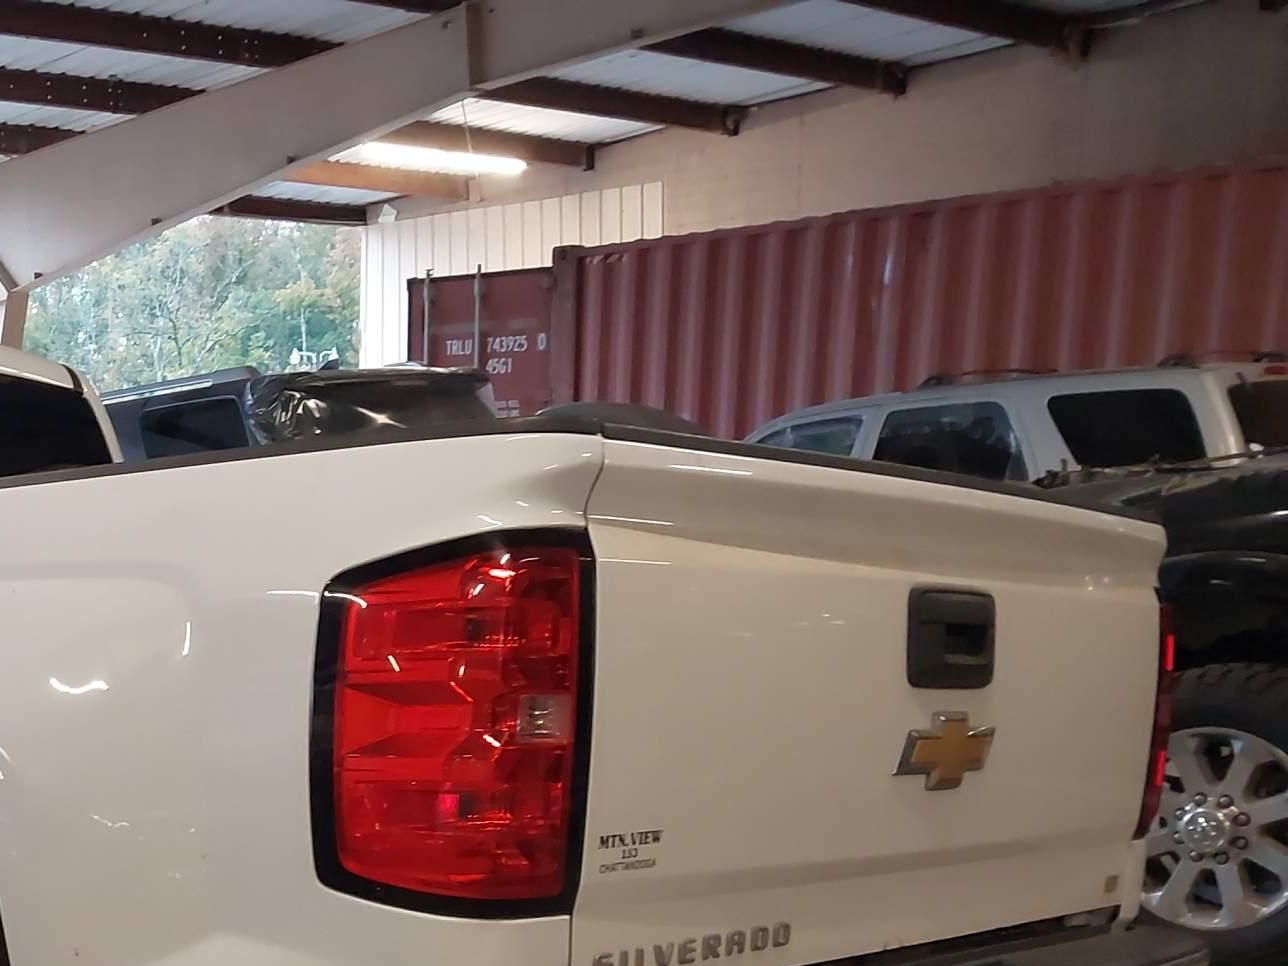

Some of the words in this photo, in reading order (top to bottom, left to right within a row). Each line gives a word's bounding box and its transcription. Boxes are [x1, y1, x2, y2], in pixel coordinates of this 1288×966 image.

[446, 339, 473, 356] TRLU
[487, 335, 528, 353] 743925
[486, 358, 512, 374] 45G1
